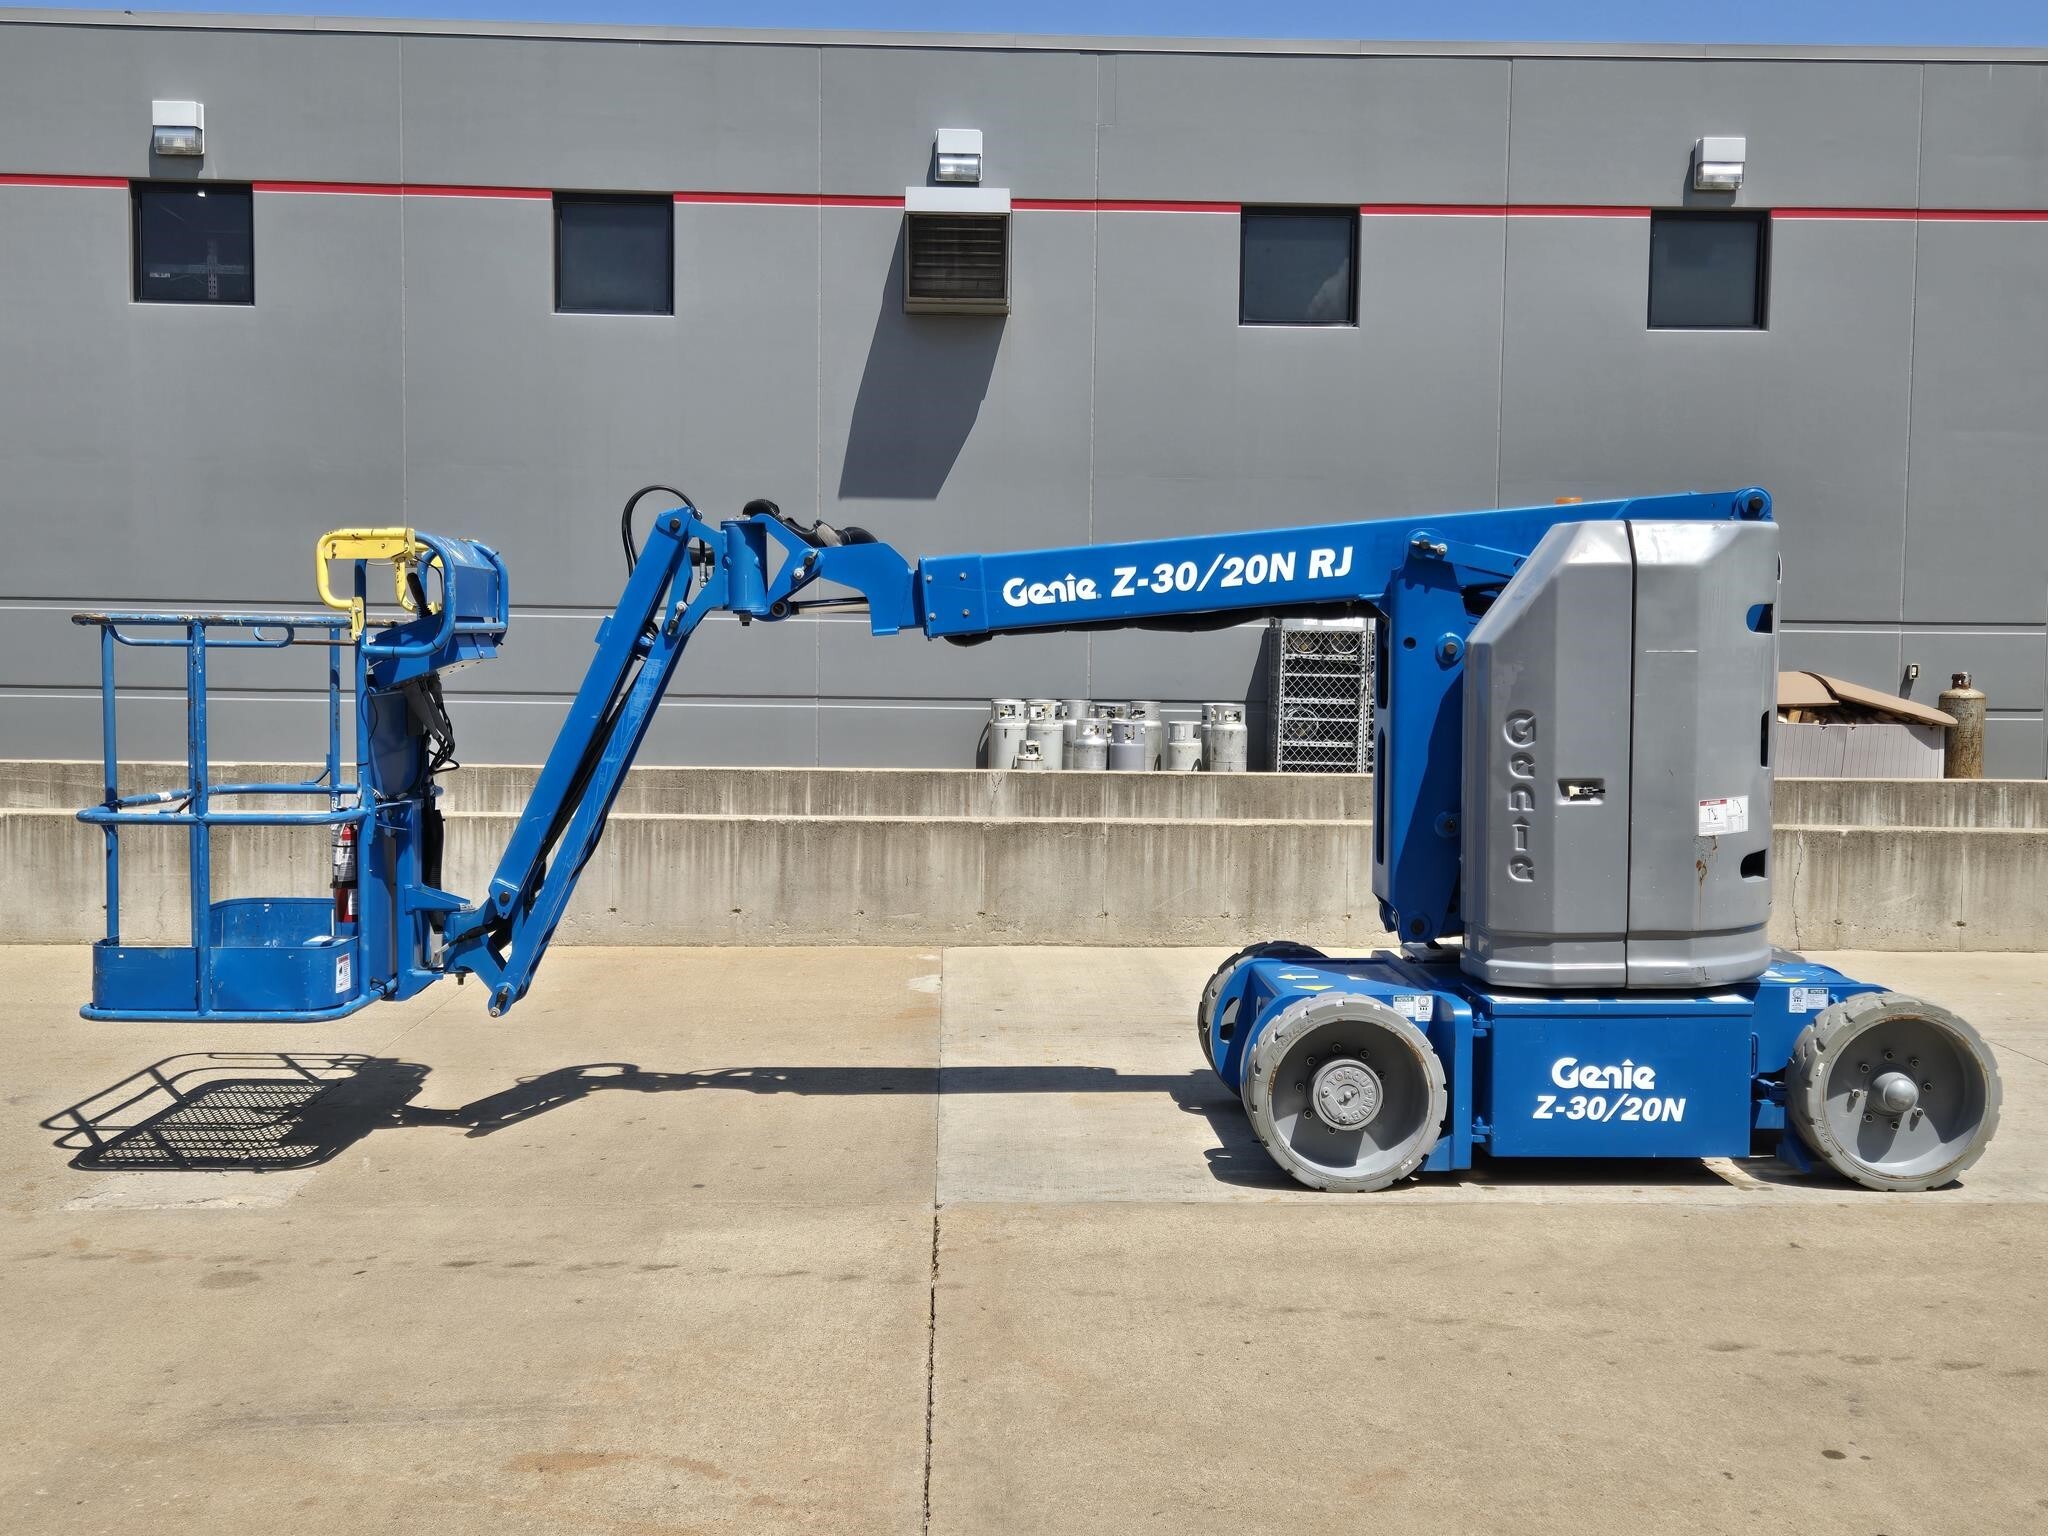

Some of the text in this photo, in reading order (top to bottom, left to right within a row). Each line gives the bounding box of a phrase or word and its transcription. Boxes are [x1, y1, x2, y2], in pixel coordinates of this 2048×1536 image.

[1002, 546, 1354, 608] Genie Z-30/20N RJ
[1503, 708, 1537, 883] Genie
[1550, 1056, 1657, 1091] Genie
[1531, 1093, 1688, 1124] Z-30/20N
